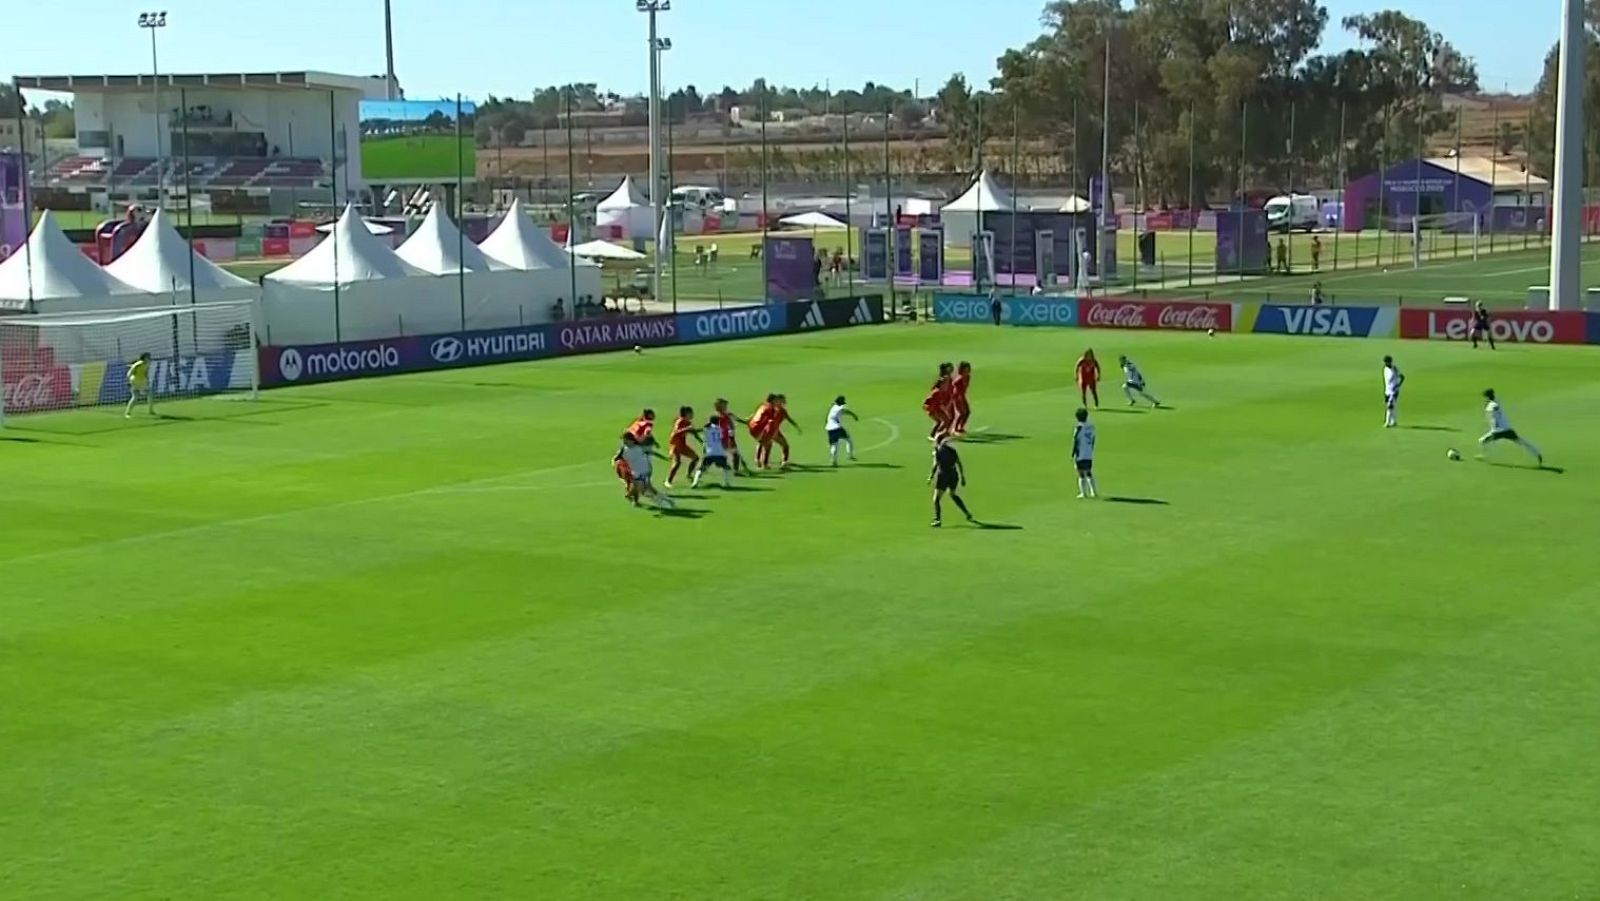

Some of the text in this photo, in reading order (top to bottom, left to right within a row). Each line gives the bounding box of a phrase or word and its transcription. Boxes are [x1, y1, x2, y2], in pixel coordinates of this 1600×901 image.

[938, 300, 989, 318] xero
[1018, 303, 1072, 322] xero
[1087, 303, 1146, 327] Coca-Cola
[1158, 306, 1219, 329] Coca-Cola
[1278, 307, 1352, 335] VISA
[561, 321, 676, 348] QATAR AIRWAYS
[697, 310, 769, 335] aramco
[468, 333, 544, 357] HYUNDAI
[307, 345, 398, 374] motorola
